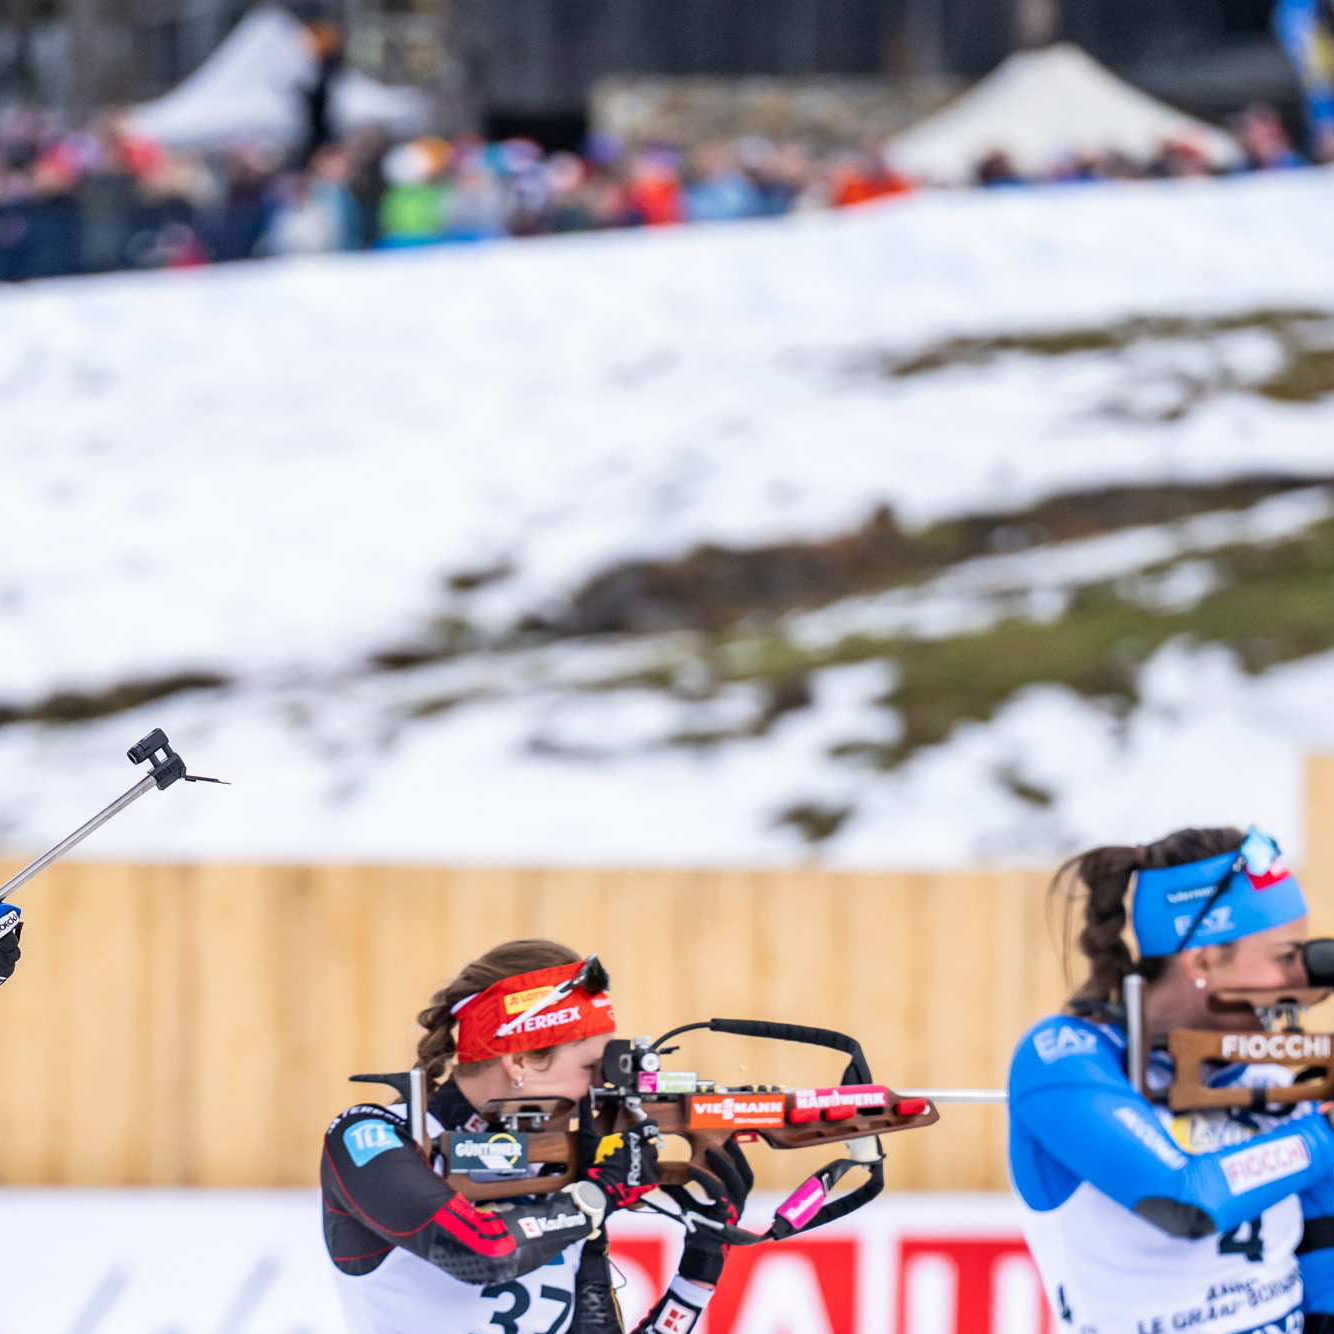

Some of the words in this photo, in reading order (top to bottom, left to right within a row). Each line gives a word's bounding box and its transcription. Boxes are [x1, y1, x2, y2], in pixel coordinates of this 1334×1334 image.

[1222, 1035, 1331, 1058] FIOCCHI
[693, 1097, 784, 1120] VIESSMANN
[1226, 1137, 1307, 1186] FIOCCHI
[1219, 1219, 1264, 1262] 4
